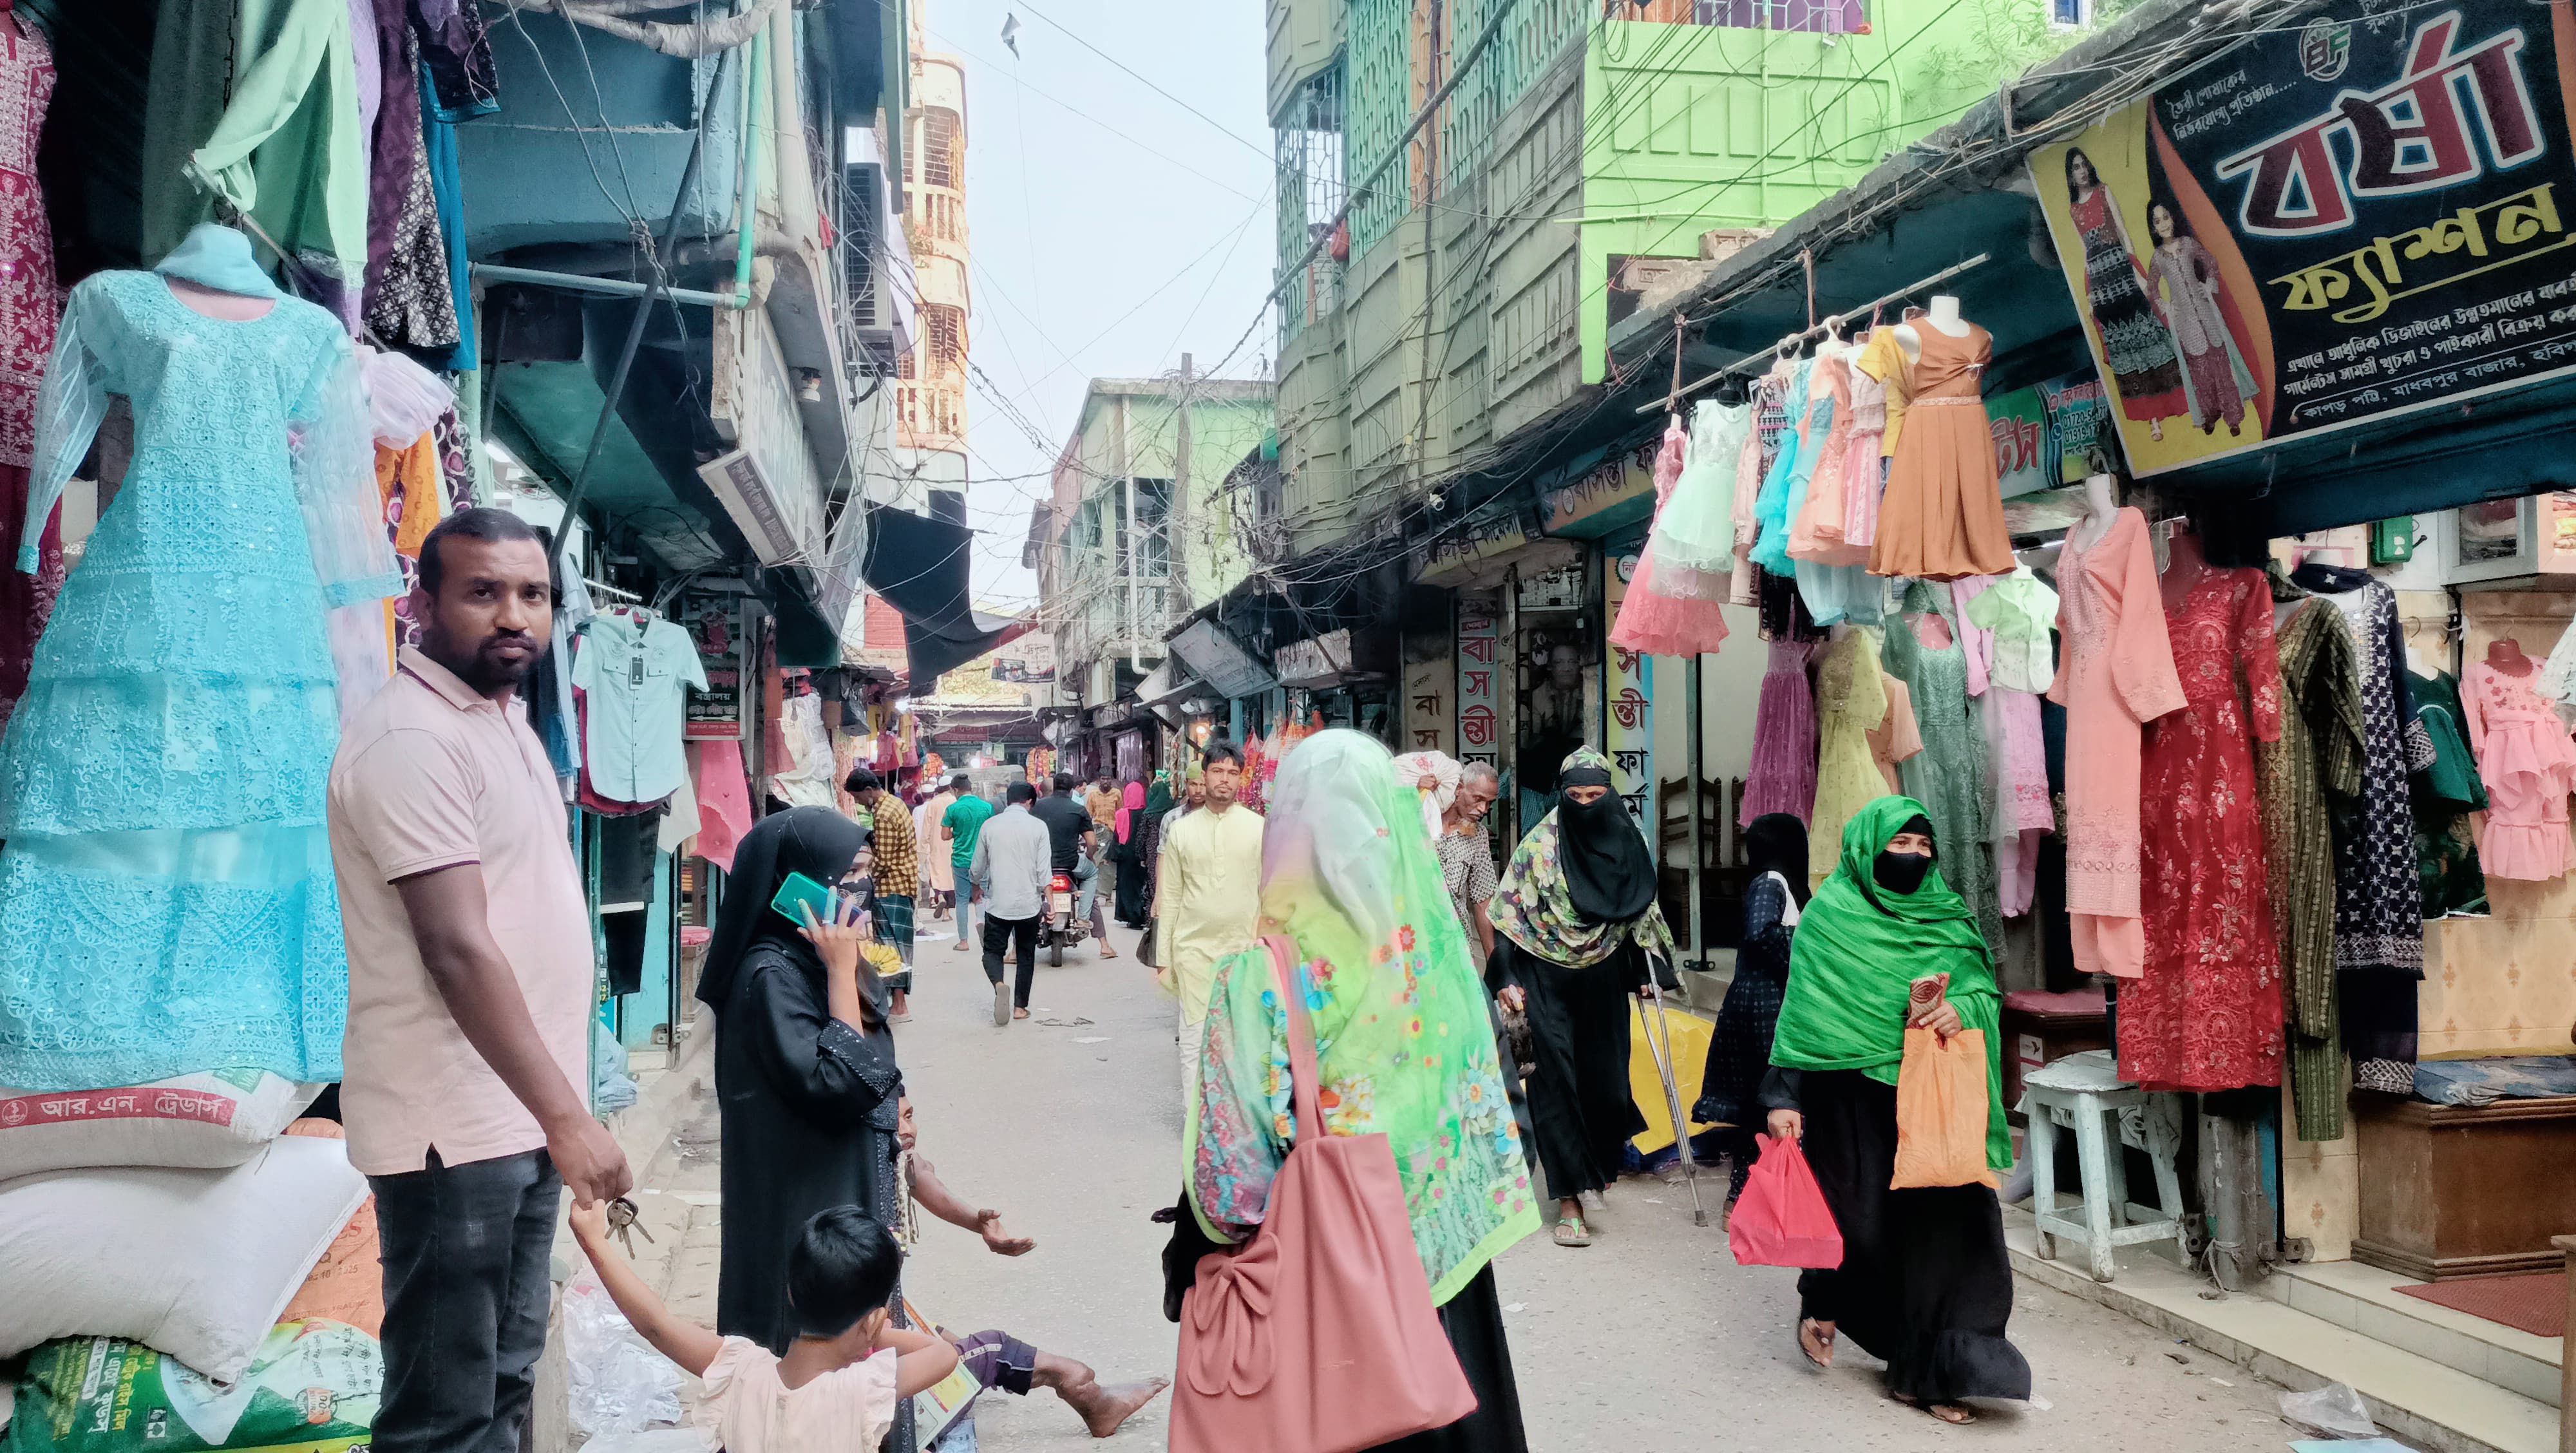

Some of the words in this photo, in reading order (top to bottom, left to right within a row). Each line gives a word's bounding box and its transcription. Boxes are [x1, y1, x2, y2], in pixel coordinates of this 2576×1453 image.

[2215, 10, 2545, 236] বর্ষা
[2266, 182, 2564, 323] ফ্যাশন
[2287, 354, 2324, 373] এখানে
[2327, 336, 2380, 363] আধুনিক
[2381, 314, 2452, 347] ডিজাইনের
[2452, 290, 2535, 325] উন্নতমানের
[2537, 271, 2576, 299] যাবত
[2338, 356, 2378, 382] সামগ্রী
[2379, 350, 2416, 377] খুচরা
[2420, 346, 2431, 360] ও
[2433, 323, 2497, 355] পাইকারী
[2497, 314, 2546, 339] বিক্রয়
[2548, 305, 2576, 323] কর
[2302, 399, 2347, 419] কাপড়
[2391, 371, 2458, 397] মাধবপুর
[155, 1092, 225, 1117] ট্রেডার্স
